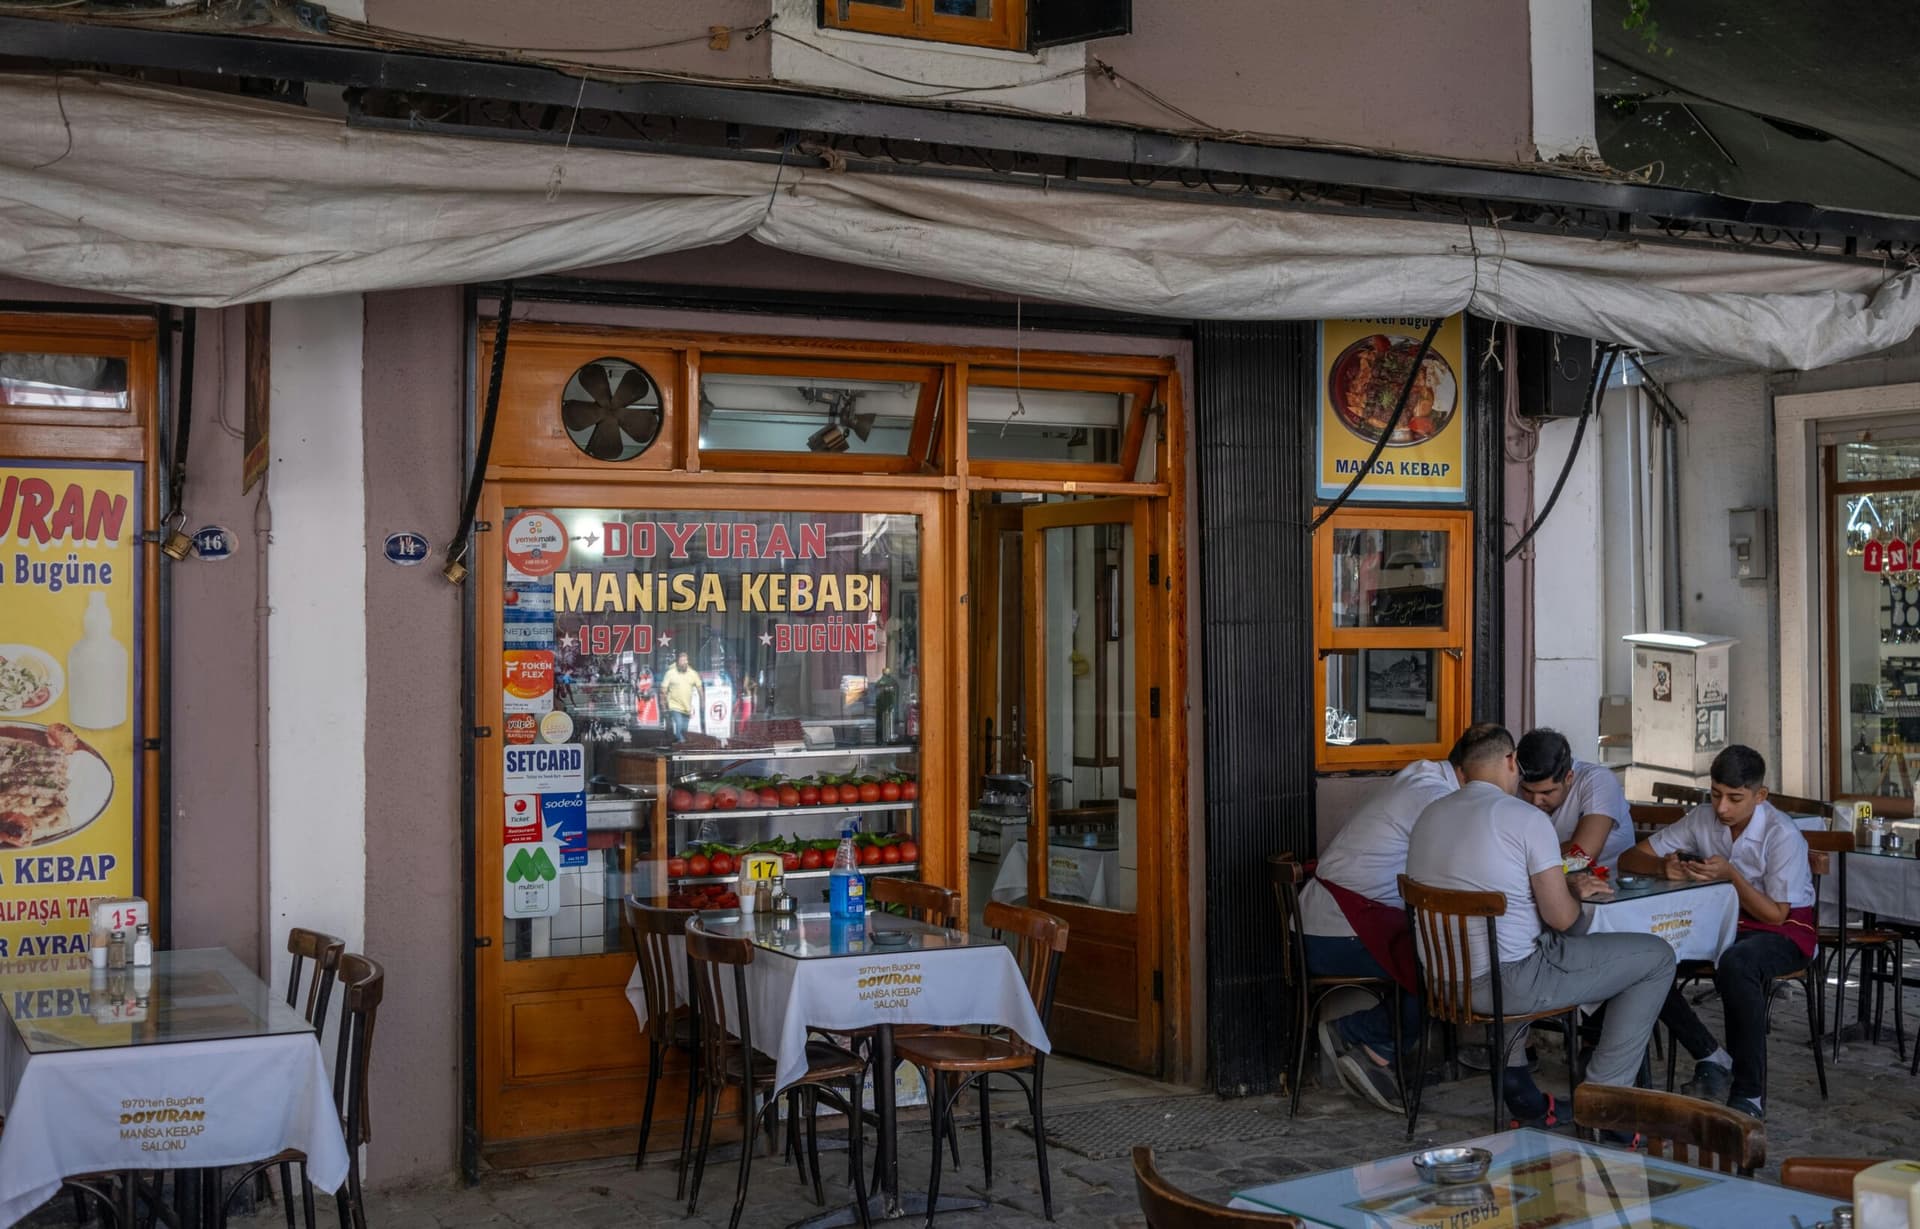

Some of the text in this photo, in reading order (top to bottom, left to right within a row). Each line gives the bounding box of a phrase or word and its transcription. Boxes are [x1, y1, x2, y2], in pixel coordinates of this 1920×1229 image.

[1400, 461, 1450, 476] KEBAP
[203, 534, 222, 550] 16
[602, 521, 827, 559] DOYURAN
[15, 554, 112, 592] Bugüne
[740, 572, 882, 613] KEBABI
[578, 616, 878, 655] 1970 BUGÜNE
[521, 661, 552, 670] TOKEN
[521, 671, 544, 679] FLEX
[506, 749, 582, 773] SETCARD
[545, 798, 583, 809] sodexo
[15, 854, 116, 884] KEBAP
[753, 861, 776, 878] 17
[112, 908, 137, 930] 15
[17, 933, 91, 956] AYRA
[857, 972, 922, 988] DOYURAN
[892, 987, 922, 997] KEBAP
[873, 998, 908, 1009] SALONU
[166, 1096, 205, 1107] Bugüne
[119, 1108, 206, 1125] DOYURAN
[165, 1124, 205, 1138] KEBAP
[141, 1138, 187, 1152] SALONU
